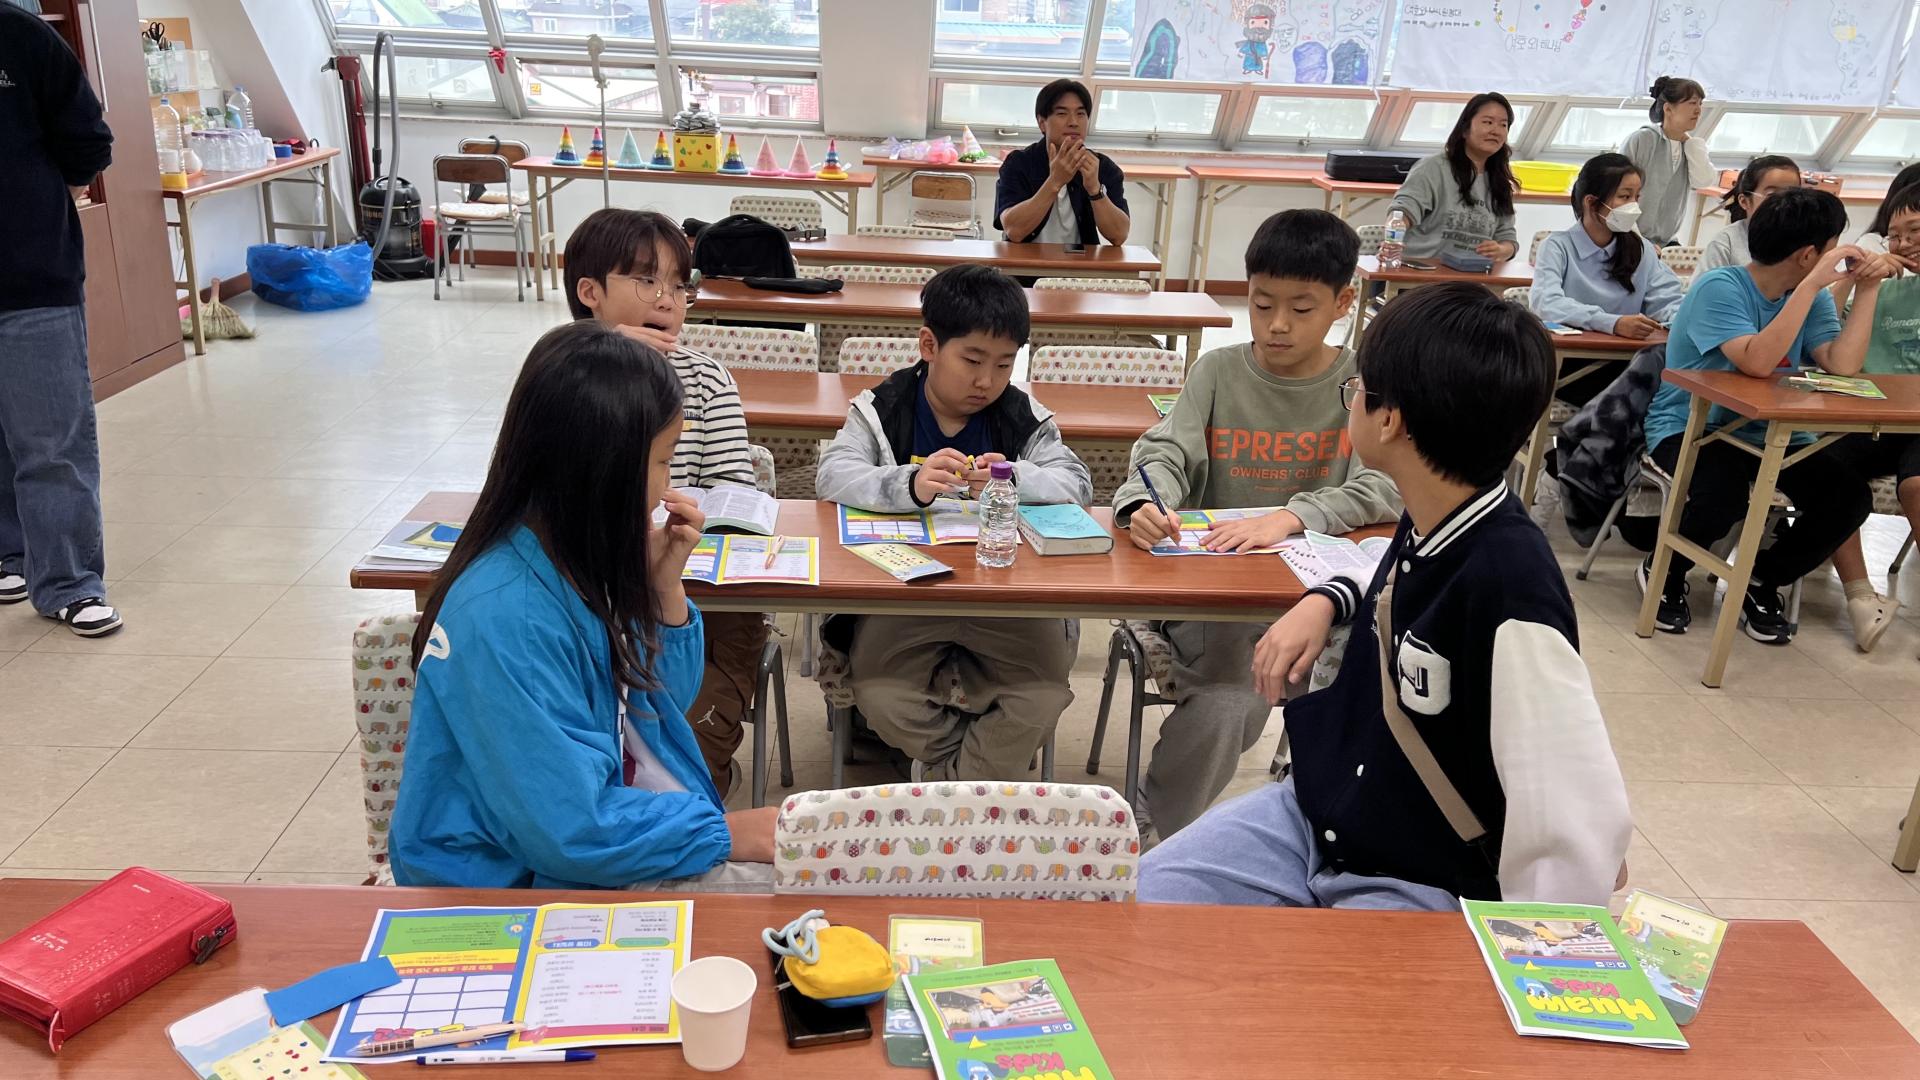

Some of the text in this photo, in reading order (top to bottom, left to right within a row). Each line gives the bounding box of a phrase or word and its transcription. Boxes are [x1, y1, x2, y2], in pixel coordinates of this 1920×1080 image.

[1295, 466, 1329, 481] CLUB
[1551, 977, 1620, 998] Kids
[1526, 994, 1657, 1021] Huam
[994, 1051, 1066, 1073] Kids
